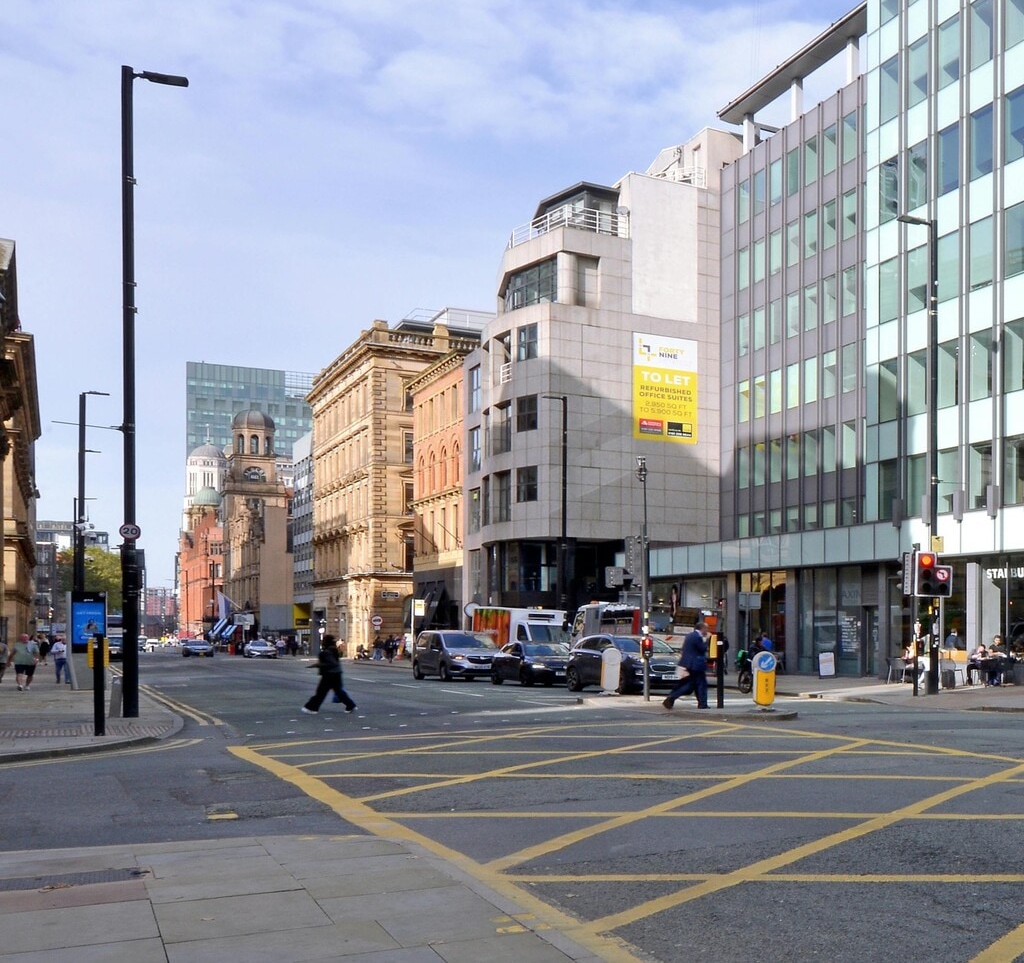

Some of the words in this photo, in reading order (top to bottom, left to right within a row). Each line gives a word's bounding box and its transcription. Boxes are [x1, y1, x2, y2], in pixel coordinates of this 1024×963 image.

[641, 370, 662, 383] TO
[665, 373, 691, 386] LET
[640, 385, 692, 395] REFURBISHED
[639, 391, 665, 399] OFFICE
[123, 527, 138, 535] 20
